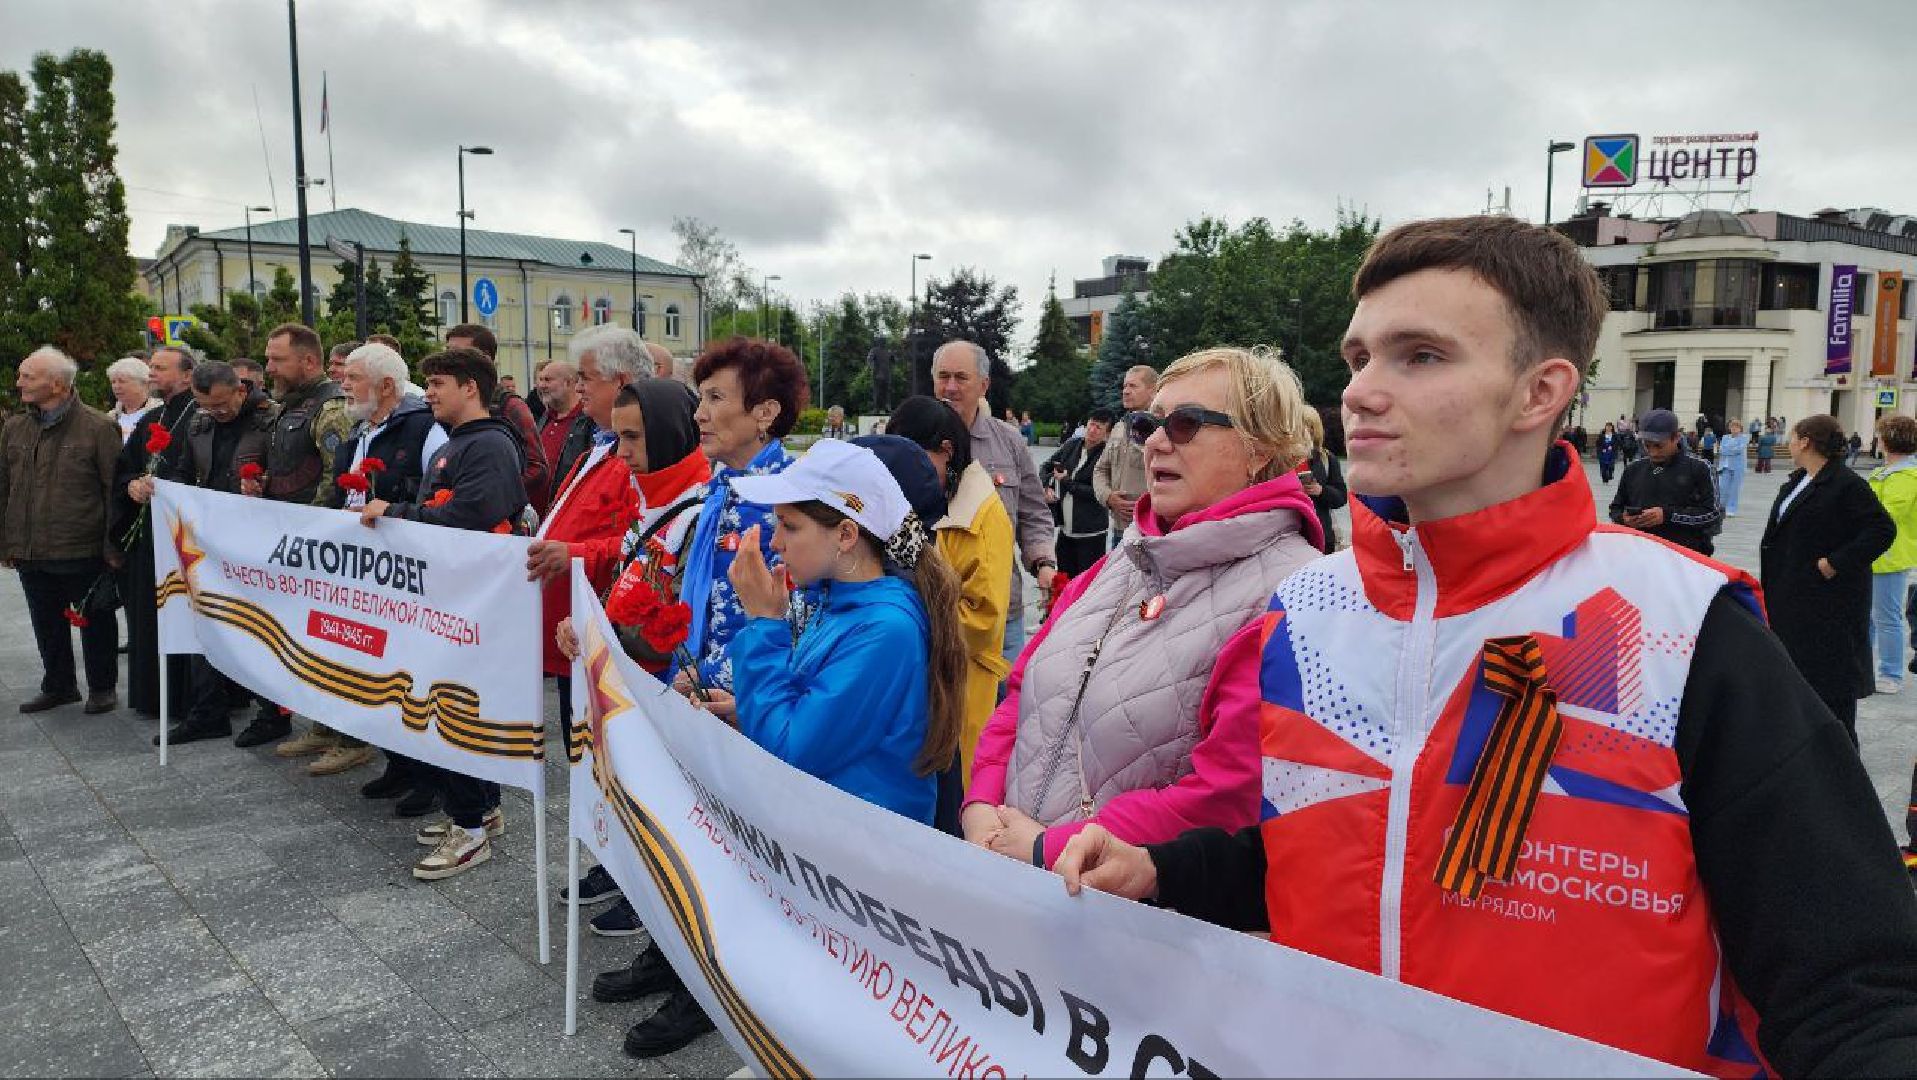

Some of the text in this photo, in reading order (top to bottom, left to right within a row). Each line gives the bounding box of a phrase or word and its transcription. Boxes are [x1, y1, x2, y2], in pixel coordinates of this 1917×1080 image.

[1649, 147, 1757, 187] центр
[1830, 273, 1853, 345] Familia
[268, 534, 428, 596] АВТОПРОБЕГ
[222, 560, 480, 647] В ЧЕСТЬ 80-ЛЕТИЯ ВЕЛИКОЙ ПОБЕДЫ
[321, 617, 363, 645] 1941-1945
[1481, 894, 1556, 923] РЯДОМ
[1485, 868, 1684, 914] МОСКОВЬЯ
[793, 852, 1046, 1036] ПОБЕДЫ
[1059, 989, 1110, 1075] В
